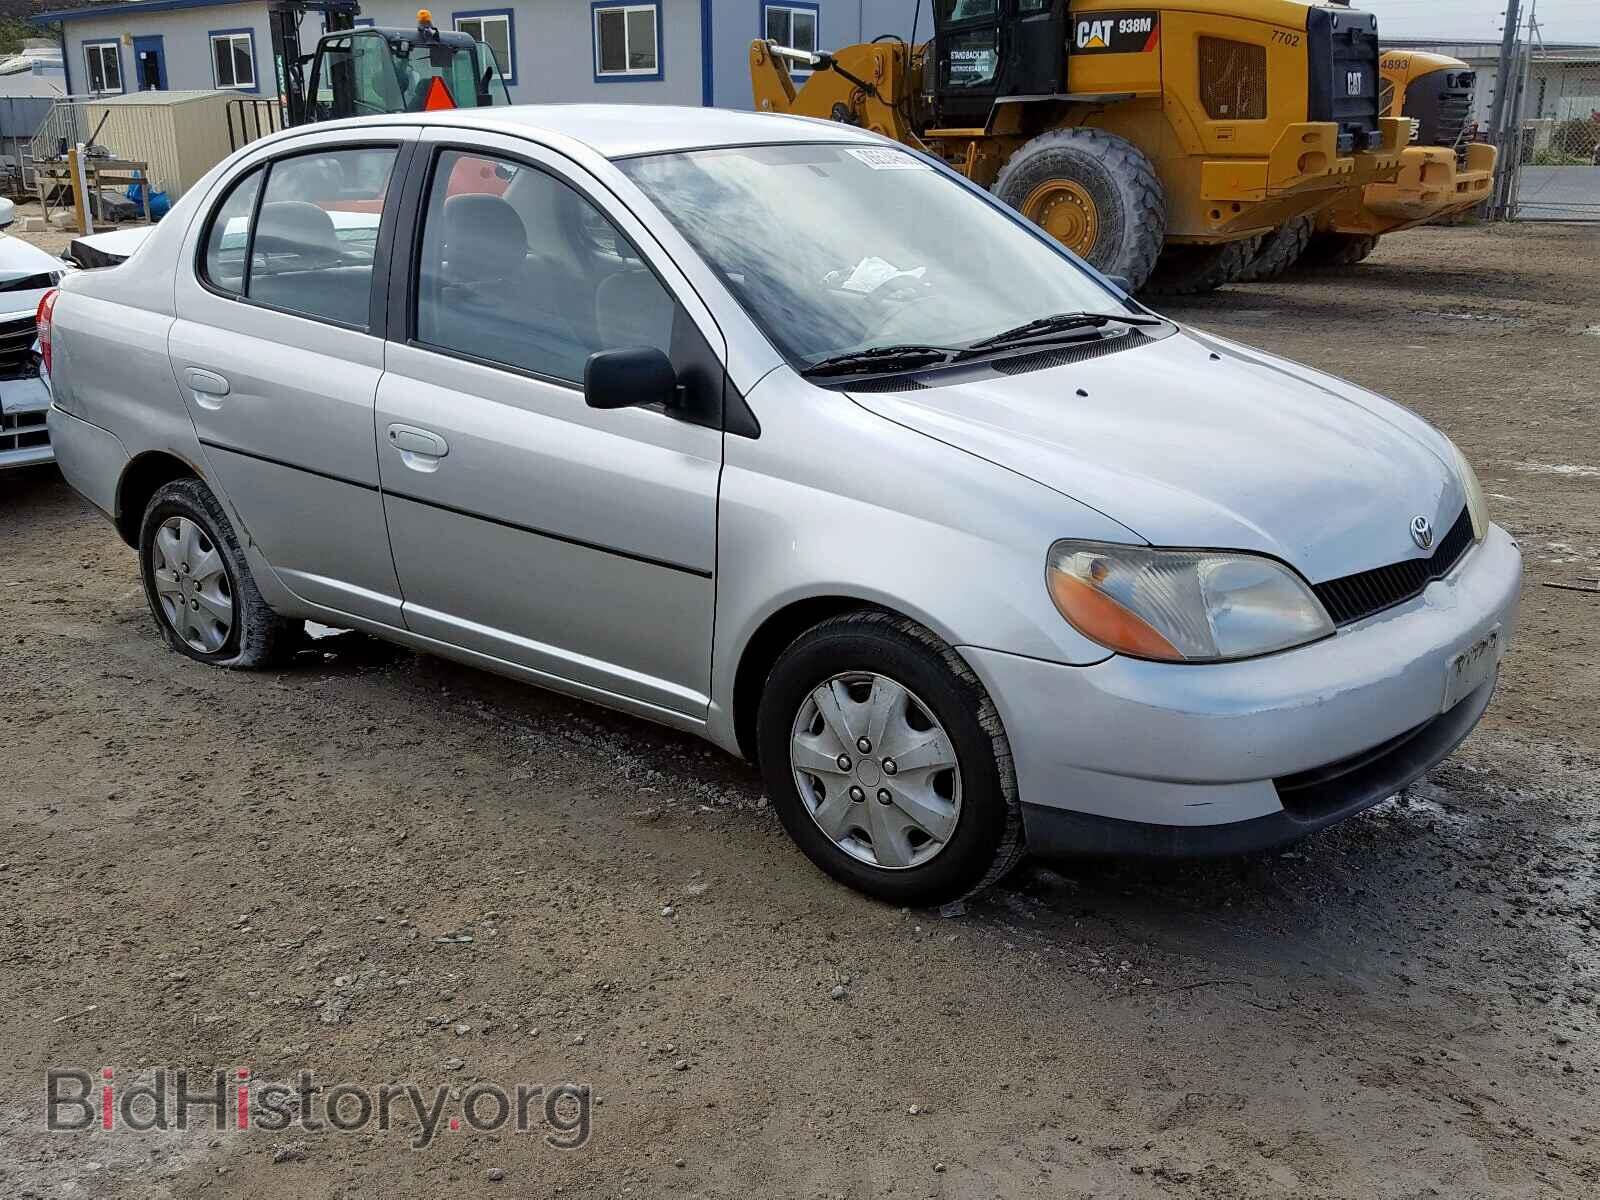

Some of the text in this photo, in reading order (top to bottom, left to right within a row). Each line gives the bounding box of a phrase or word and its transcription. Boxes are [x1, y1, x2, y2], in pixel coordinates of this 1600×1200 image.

[1077, 18, 1151, 48] CAT 938M
[1271, 30, 1300, 47] 7702
[1381, 59, 1408, 70] 4893
[1347, 71, 1361, 96] CAT
